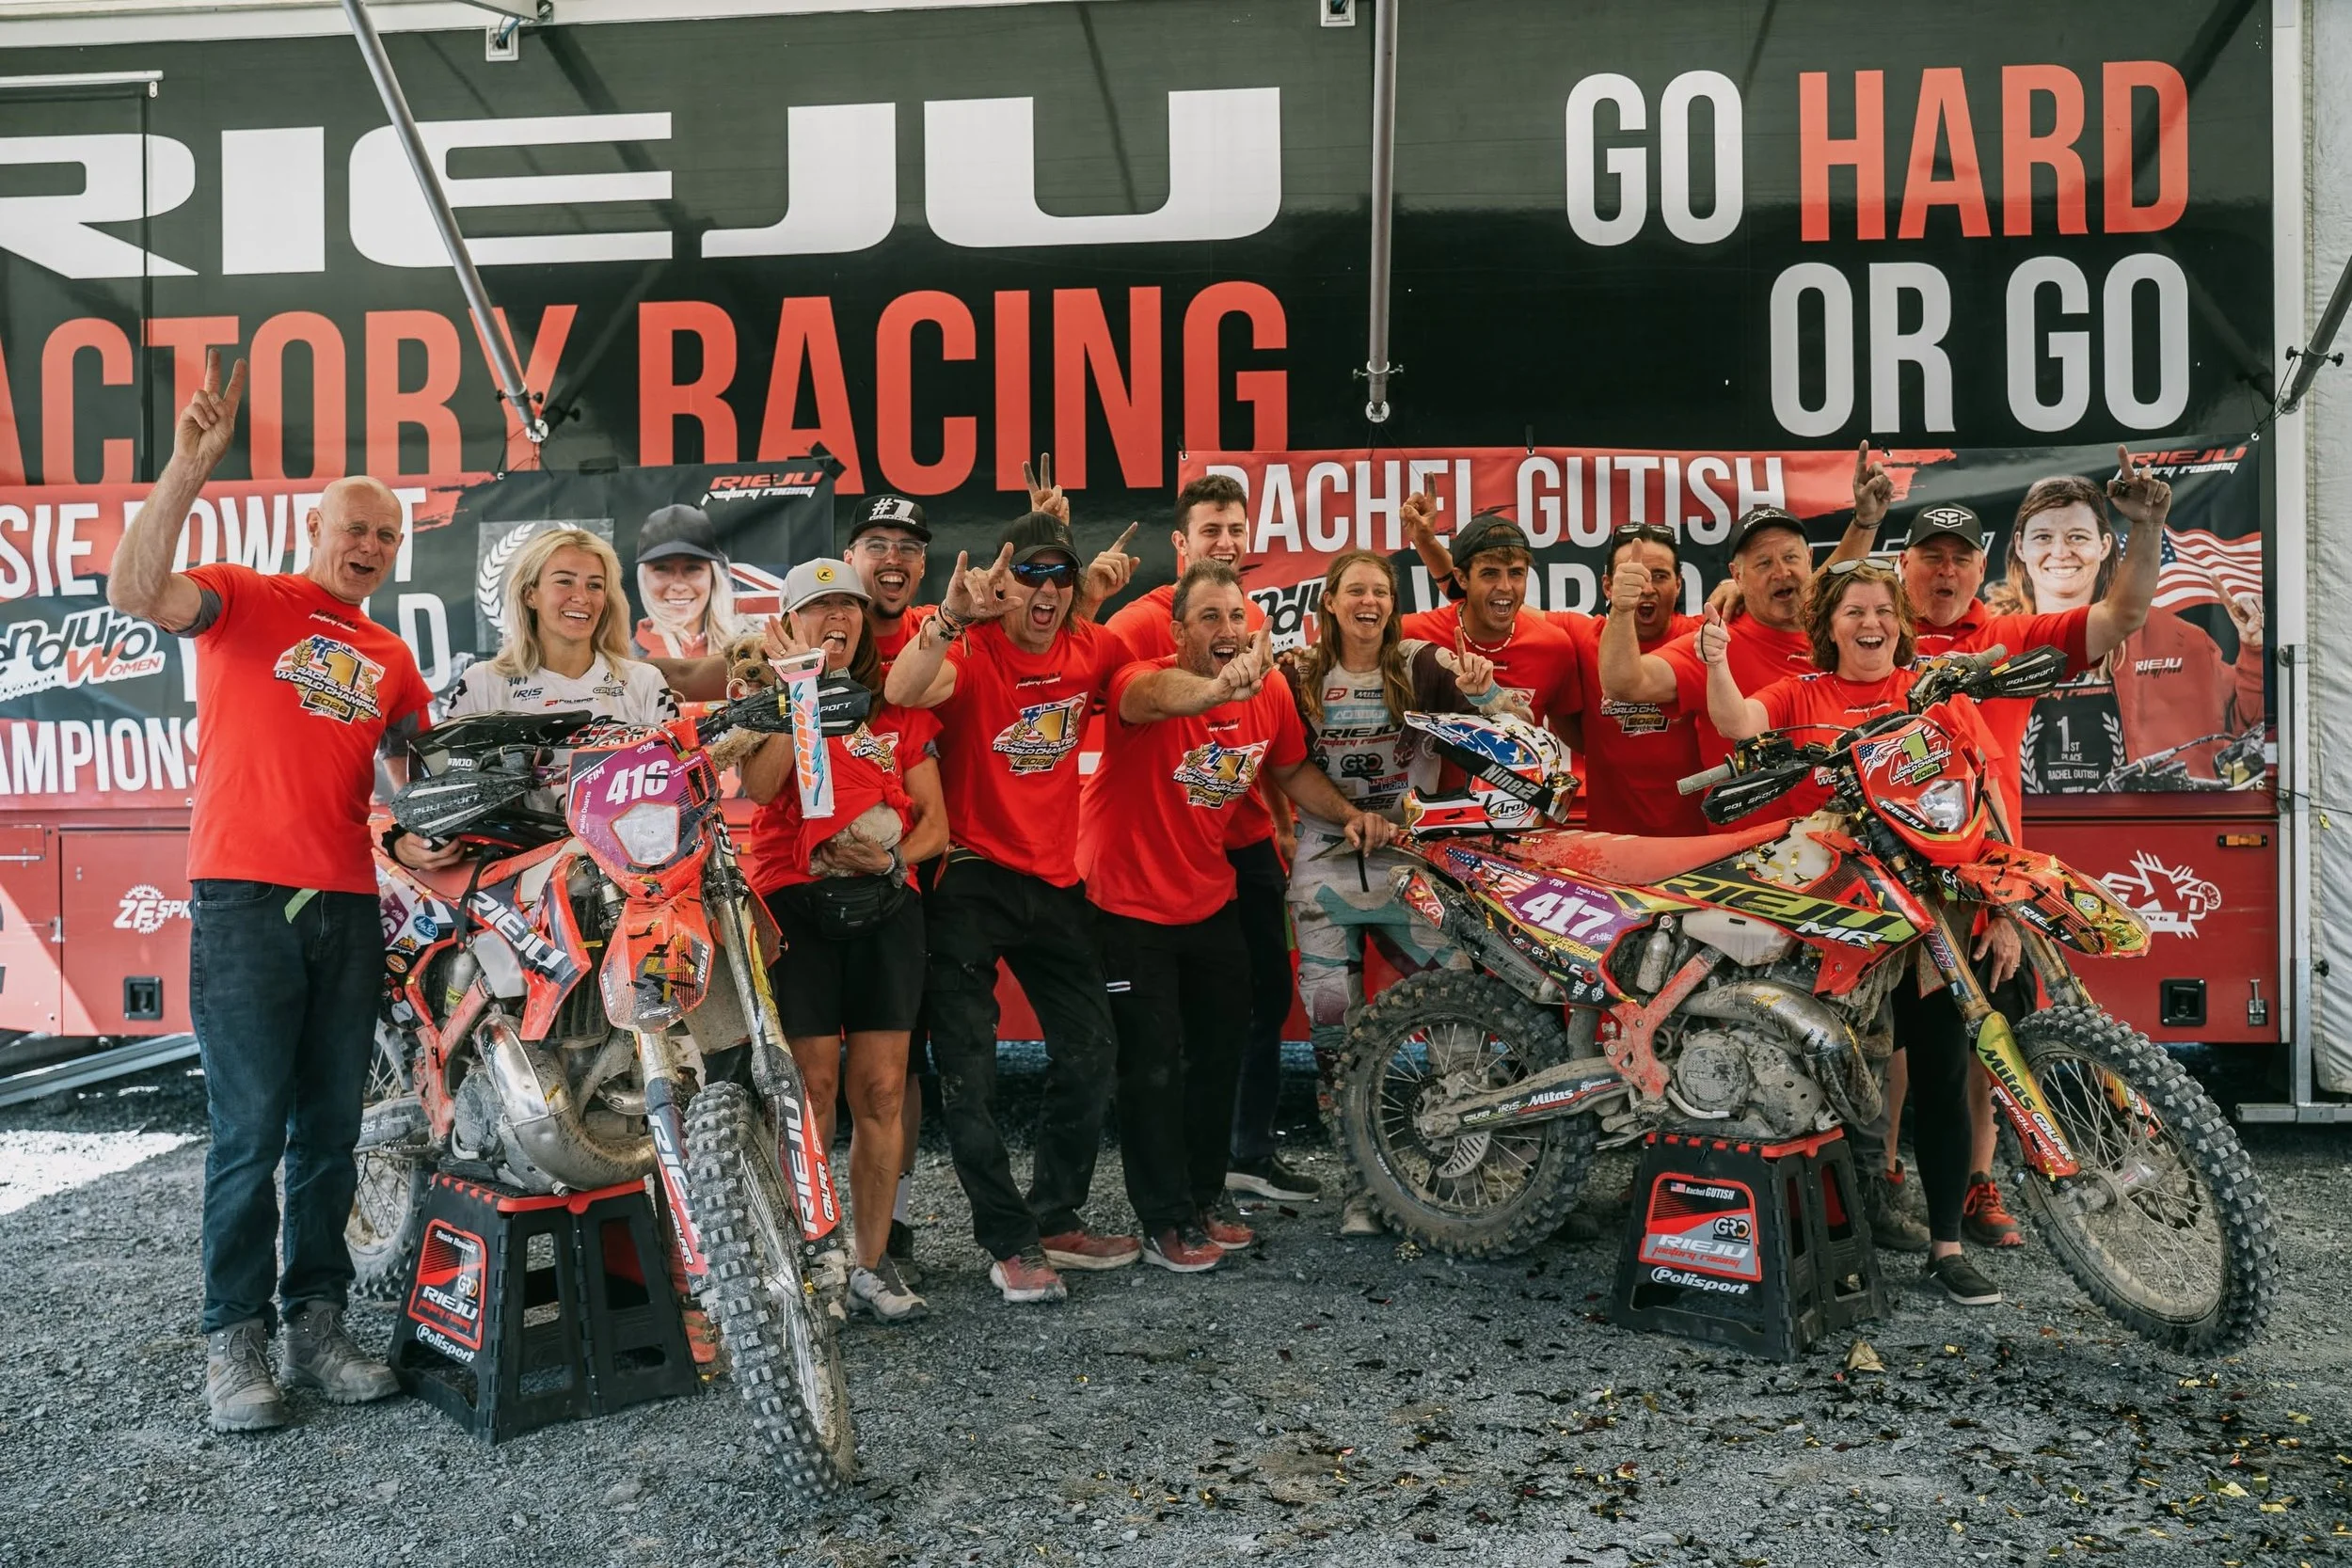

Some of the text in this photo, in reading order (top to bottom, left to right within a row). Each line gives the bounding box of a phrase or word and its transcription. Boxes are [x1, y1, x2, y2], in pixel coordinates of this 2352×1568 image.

[1565, 60, 2189, 246] GO HARD
[0, 87, 1281, 280] RIEJU
[1770, 253, 2189, 437] OR GO
[0, 280, 1288, 497] CTORY RACING
[2128, 446, 2247, 465] RIEJU
[709, 471, 823, 490] RIEJU
[872, 499, 914, 516] #1
[1517, 457, 1787, 549] GUTISH
[2006, 666, 2057, 687] POLISPORT
[2135, 657, 2183, 671] RIEJU
[275, 670, 382, 719] WORLD CHAMPION
[296, 666, 378, 707] RACHEL GUTISH
[310, 695, 347, 714] 2026
[513, 687, 544, 698] IRIS
[993, 743, 1035, 755] WORLD
[2061, 753, 2083, 762] PLACE
[605, 760, 670, 805] 416
[1891, 767, 1918, 782] WORLD
[2048, 769, 2099, 780] RACHEL GUTISH
[1880, 800, 1925, 830] RIEJU
[1520, 892, 1615, 938] 417
[1653, 874, 1916, 942] RIEJU
[468, 891, 568, 969] RIEJU
[696, 944, 709, 984] RIEJU
[1978, 1047, 2035, 1111] Mitas
[1499, 1101, 1521, 1114] IRIS
[1528, 1089, 1574, 1107] Mitas
[2010, 1105, 2065, 1170] POLIPORT
[2031, 1112, 2074, 1162] GALFER
[783, 1096, 818, 1234] RIEJU
[822, 1162, 835, 1221] GALFER
[1686, 1186, 1735, 1200] Rachel GUTISH
[1713, 1217, 1750, 1239] GRO
[1658, 1234, 1749, 1259] RIEJU
[1656, 1268, 1750, 1295] Polisport
[422, 1285, 478, 1321] RIEJU
[420, 1327, 475, 1363] Polisport
